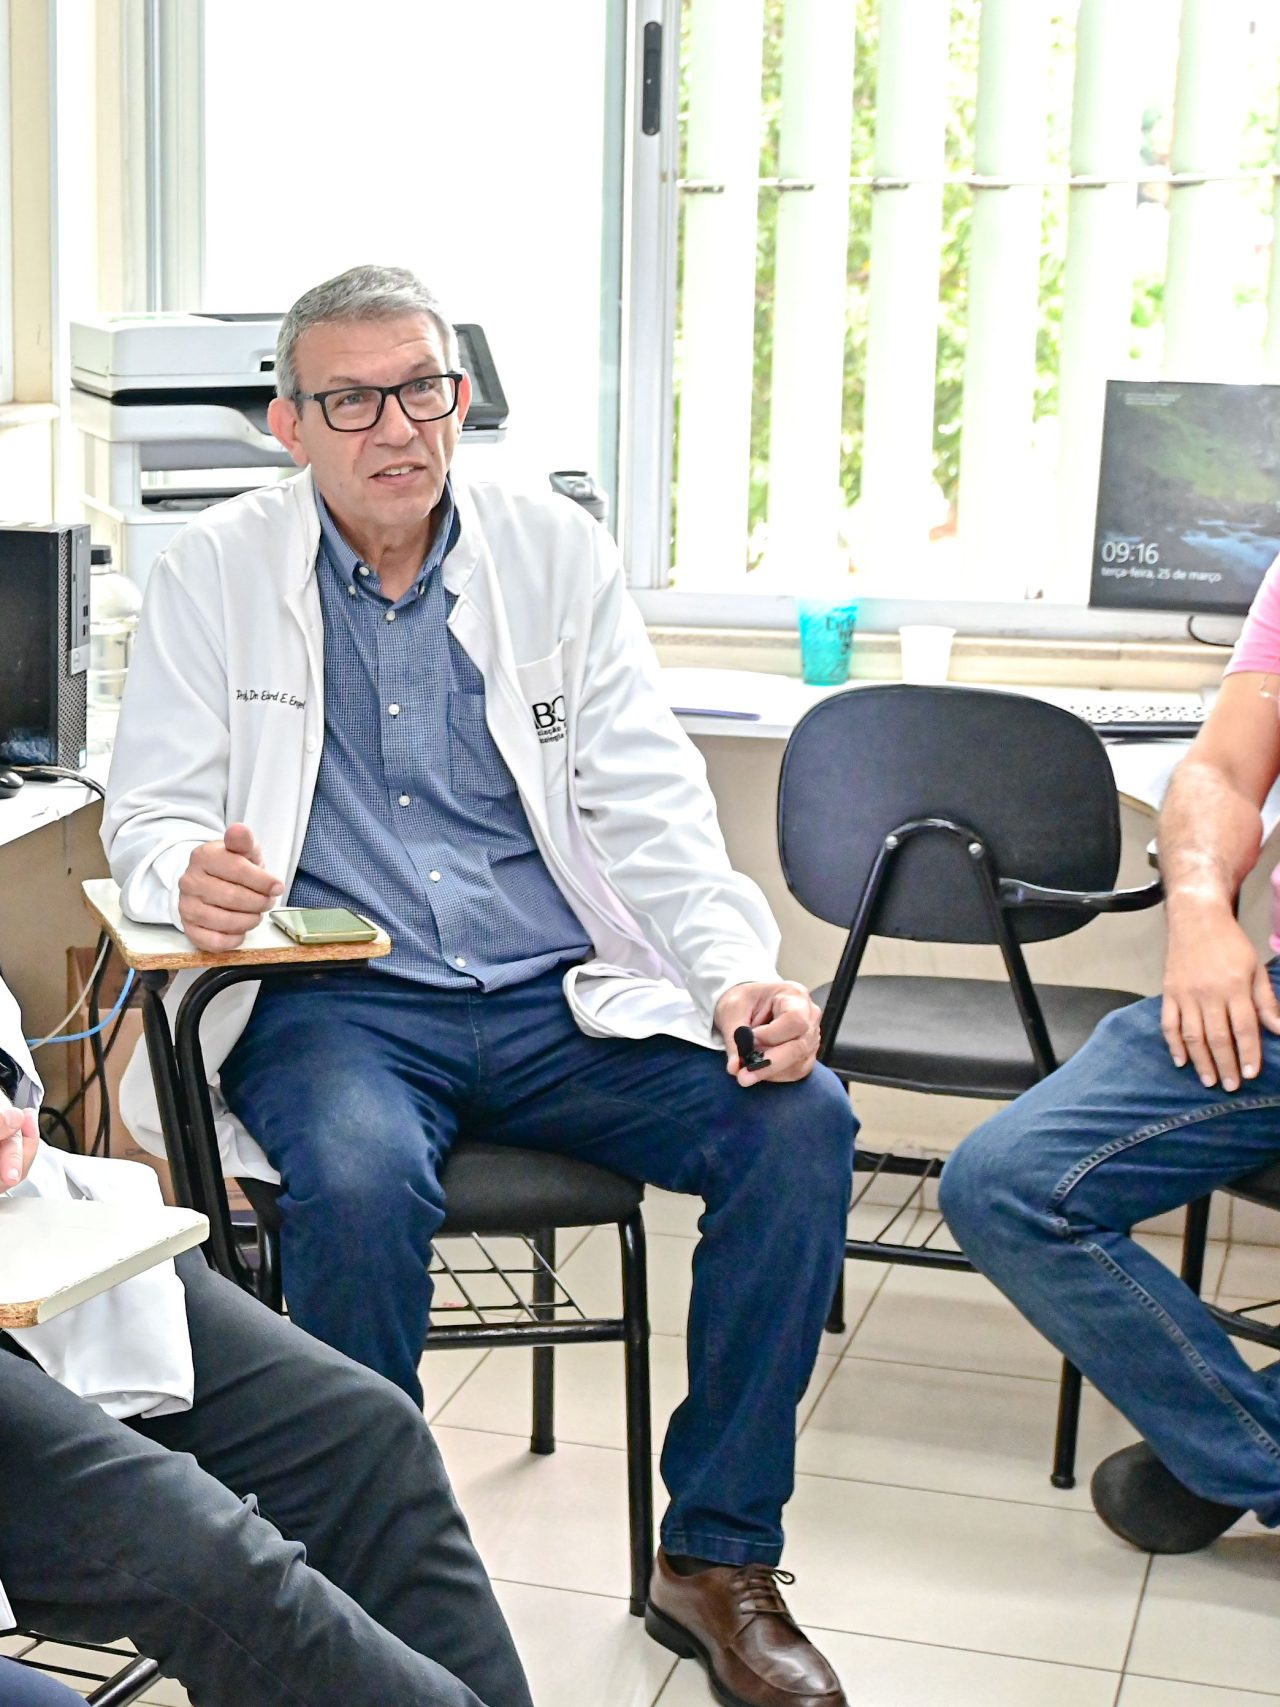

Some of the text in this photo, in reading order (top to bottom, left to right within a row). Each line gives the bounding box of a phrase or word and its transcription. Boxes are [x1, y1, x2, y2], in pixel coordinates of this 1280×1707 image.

[1101, 541, 1160, 565] 09:16
[1157, 568, 1171, 580] 25
[1172, 569, 1187, 580] de
[1188, 571, 1223, 583] março
